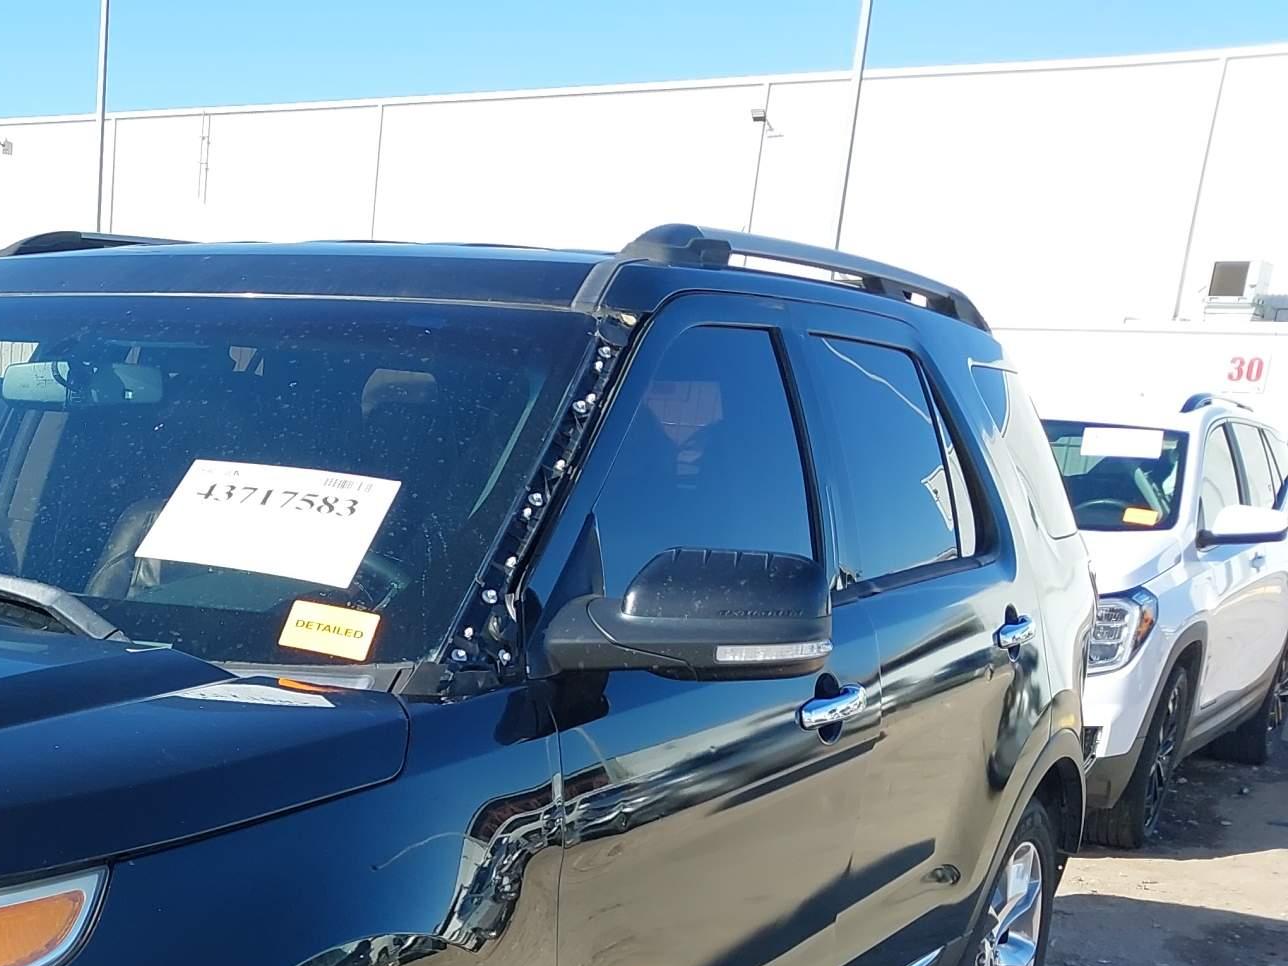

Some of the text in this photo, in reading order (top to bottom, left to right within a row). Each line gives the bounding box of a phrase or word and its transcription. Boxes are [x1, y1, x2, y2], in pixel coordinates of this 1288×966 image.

[1227, 356, 1264, 382] 30
[196, 483, 359, 516] 43717583
[295, 620, 364, 639] DETAILED
